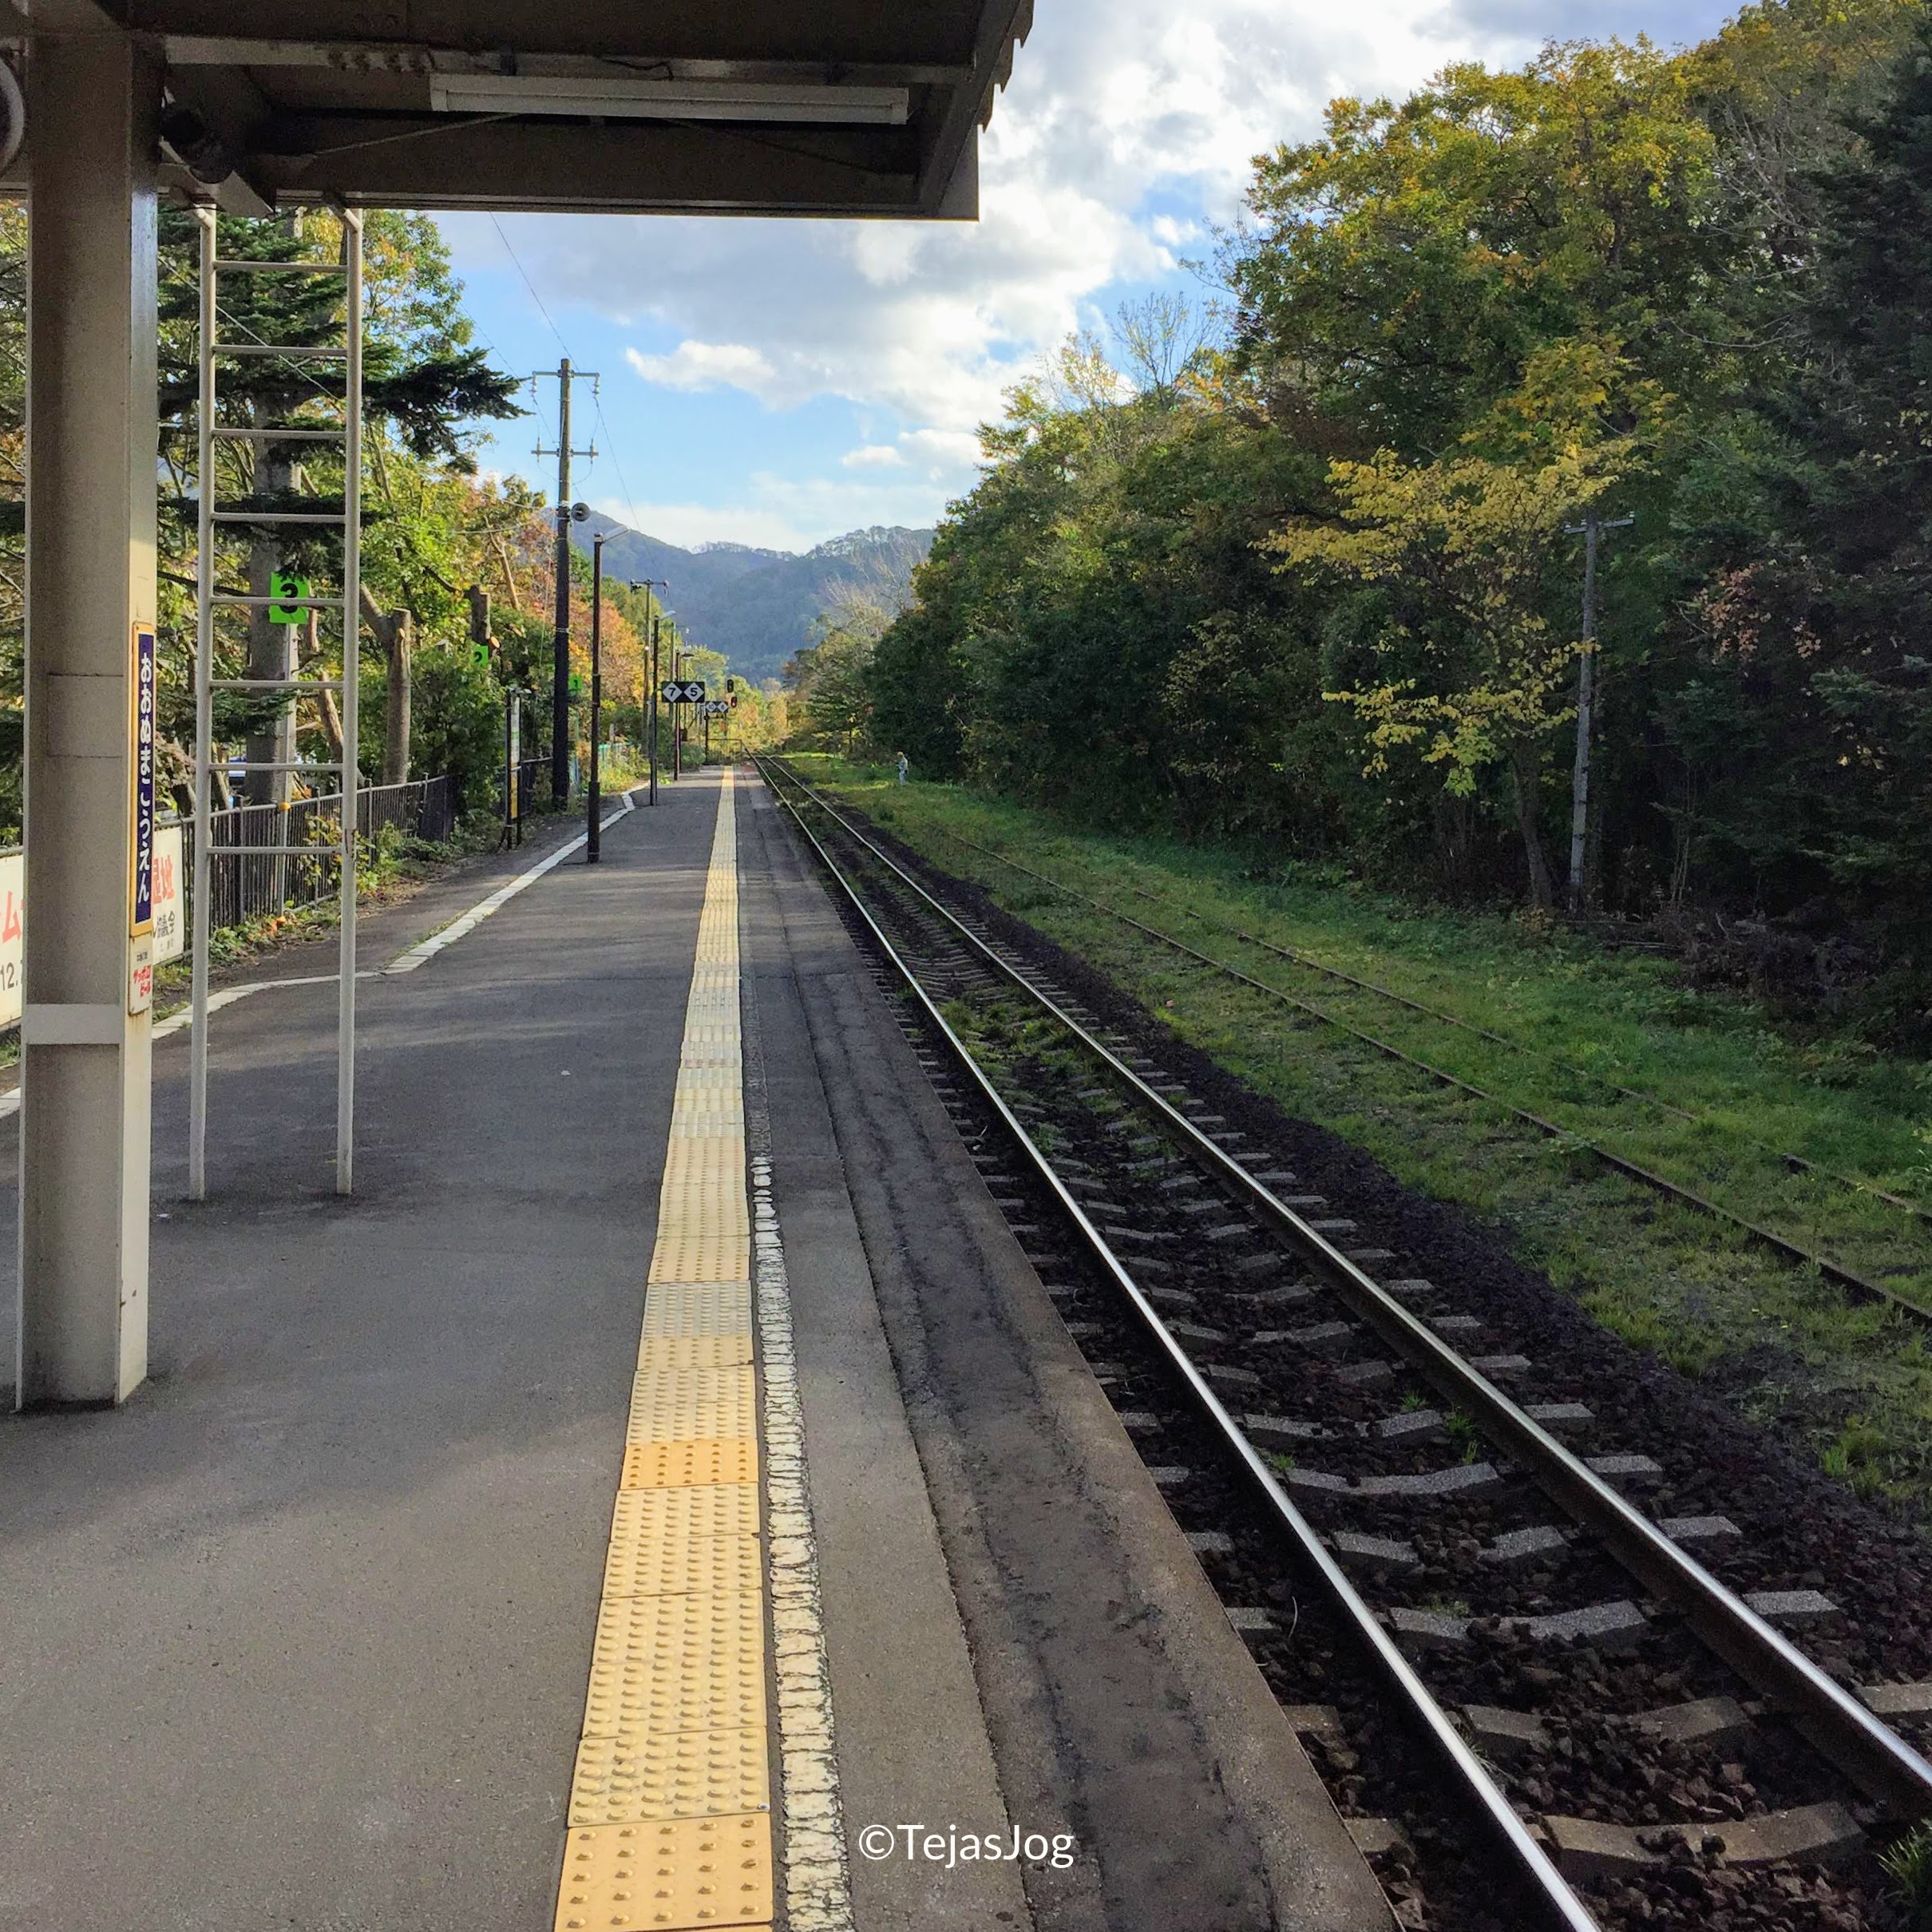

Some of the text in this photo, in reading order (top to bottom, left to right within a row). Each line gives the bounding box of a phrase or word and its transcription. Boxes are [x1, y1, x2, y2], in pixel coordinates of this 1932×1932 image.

[280, 583, 299, 614] 3
[668, 687, 698, 697] 7 5
[138, 652, 152, 904] おおぬまこうえん
